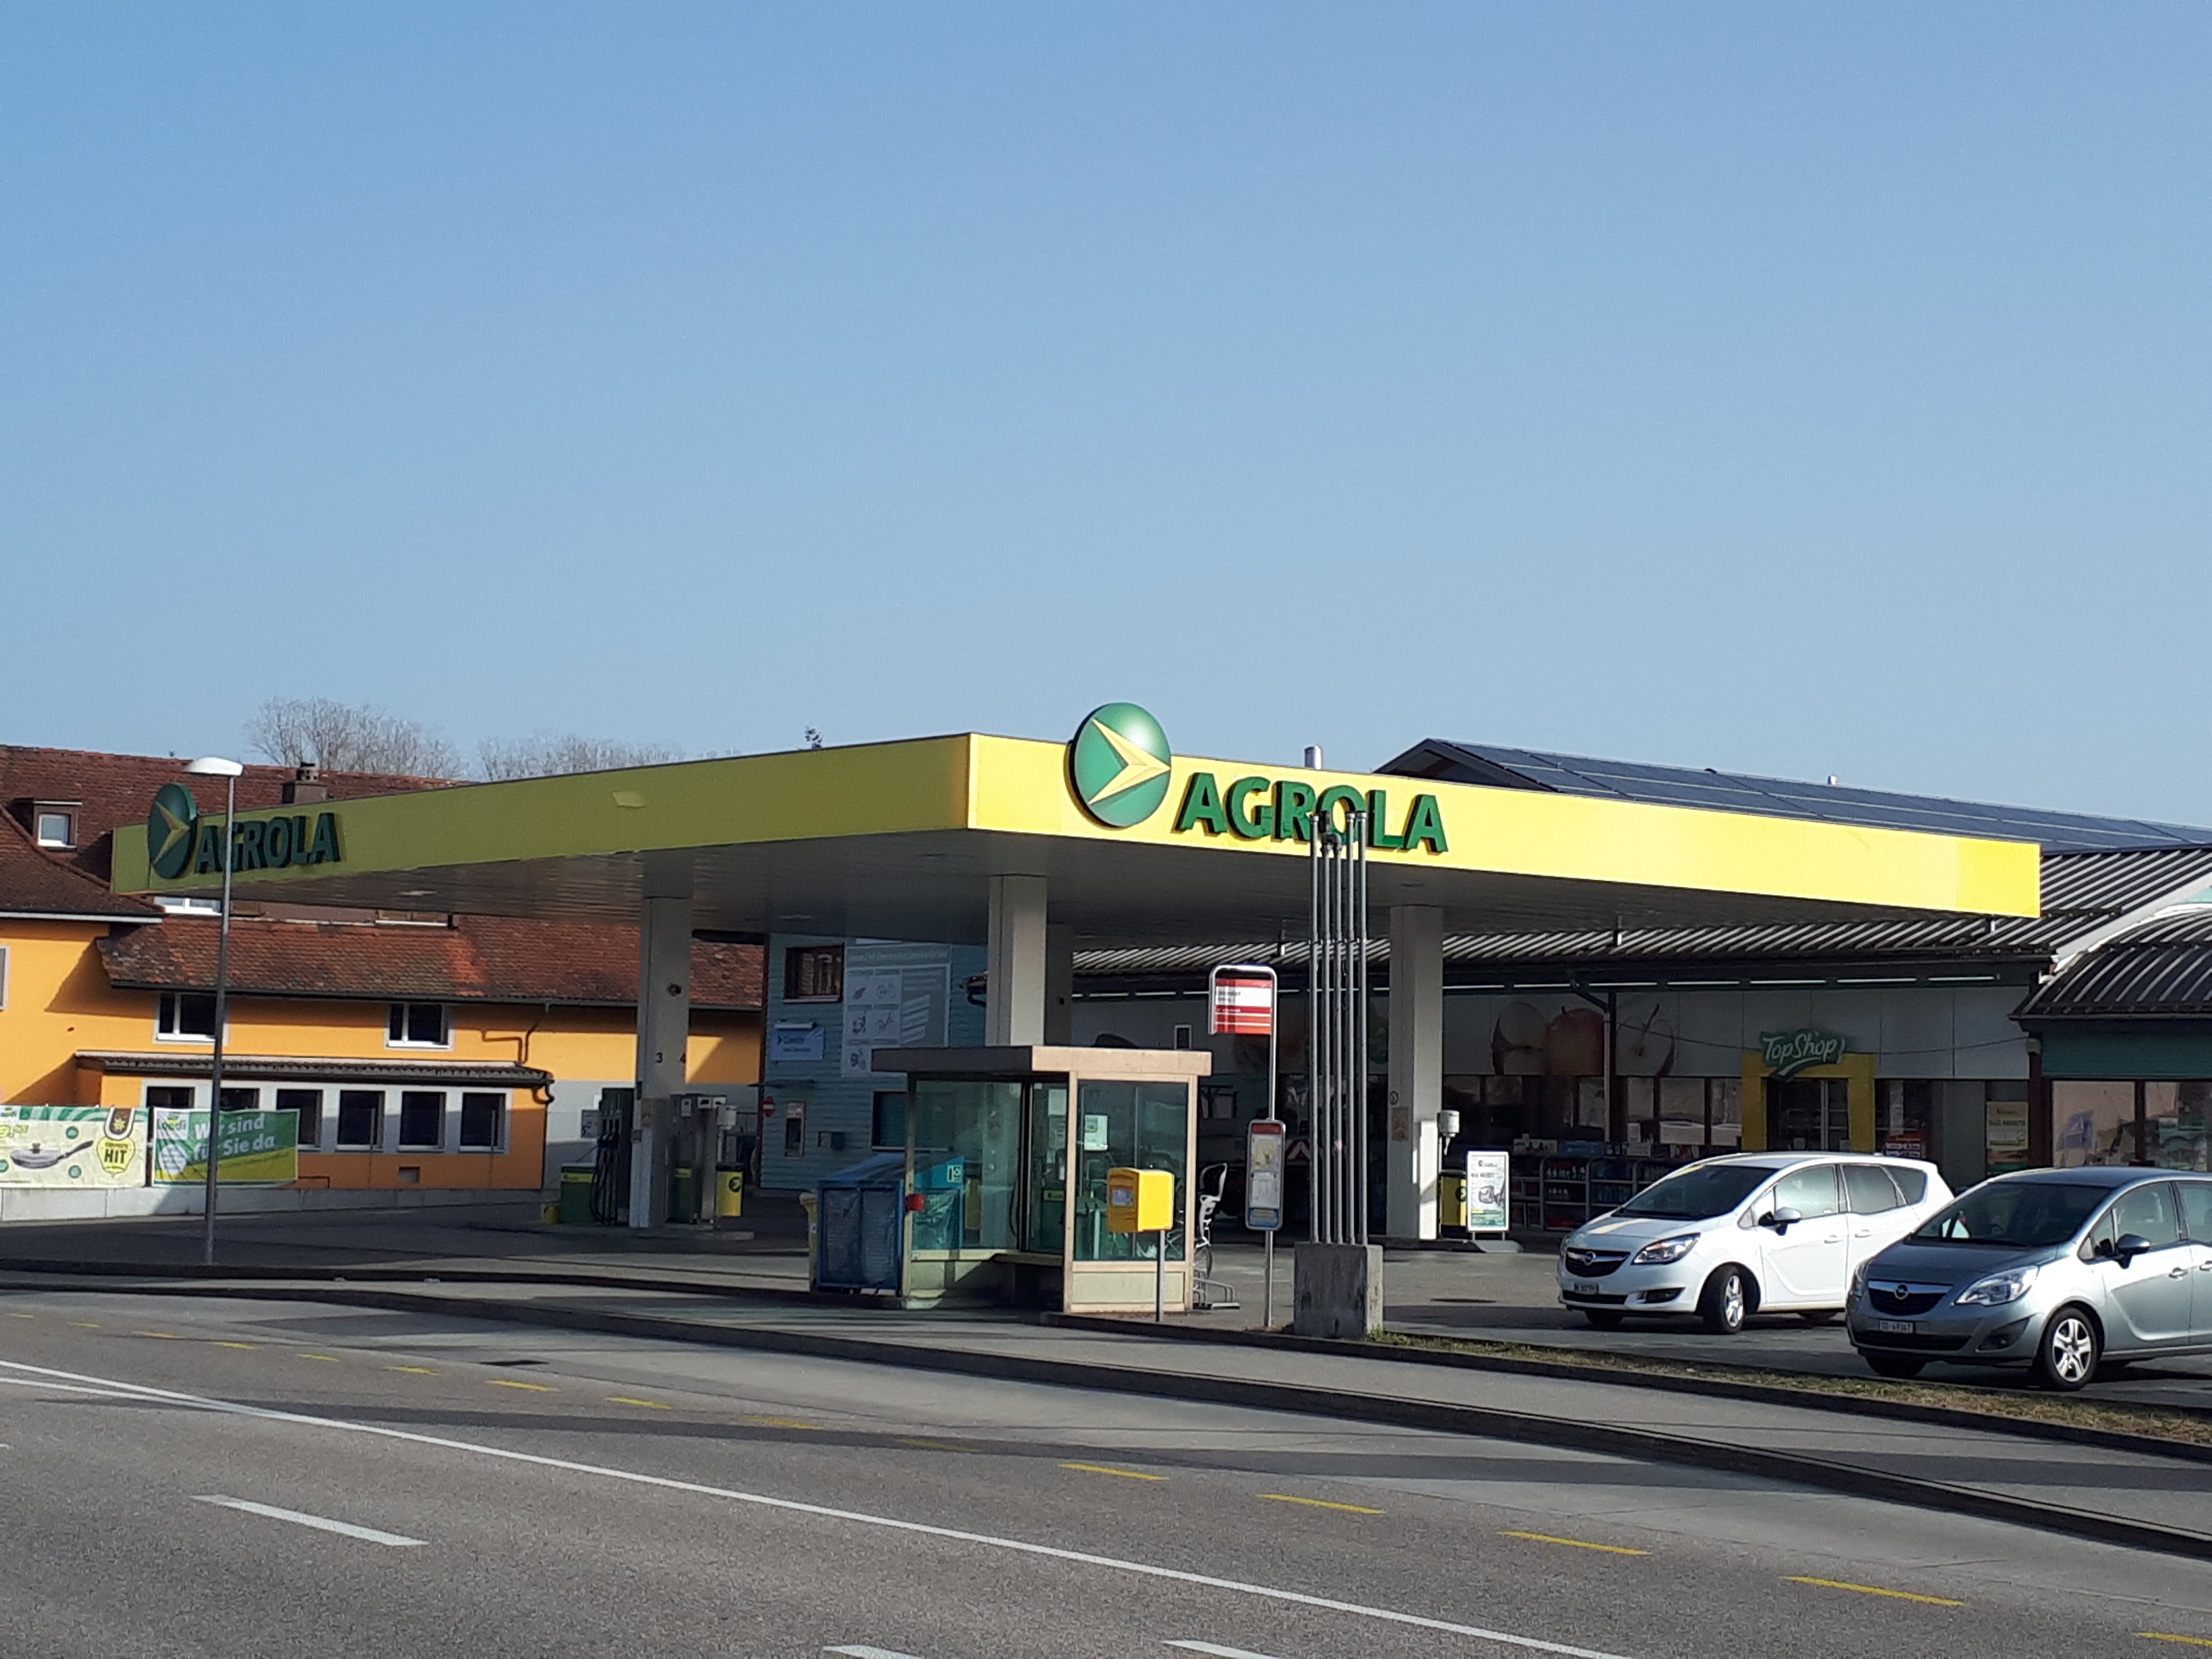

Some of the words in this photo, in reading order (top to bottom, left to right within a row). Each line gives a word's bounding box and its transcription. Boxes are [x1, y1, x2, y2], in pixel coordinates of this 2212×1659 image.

[1173, 772, 1449, 854] AGROLA
[195, 813, 340, 874] AGROLA
[656, 1052, 663, 1064] 3
[679, 1052, 686, 1064] 4
[1762, 1032, 1838, 1064] TopShop
[195, 1119, 224, 1140] Wr
[228, 1112, 265, 1134] sind
[104, 1148, 128, 1164] HIT
[194, 1142, 220, 1161] fü
[223, 1138, 250, 1156] Sie
[252, 1133, 276, 1151] da
